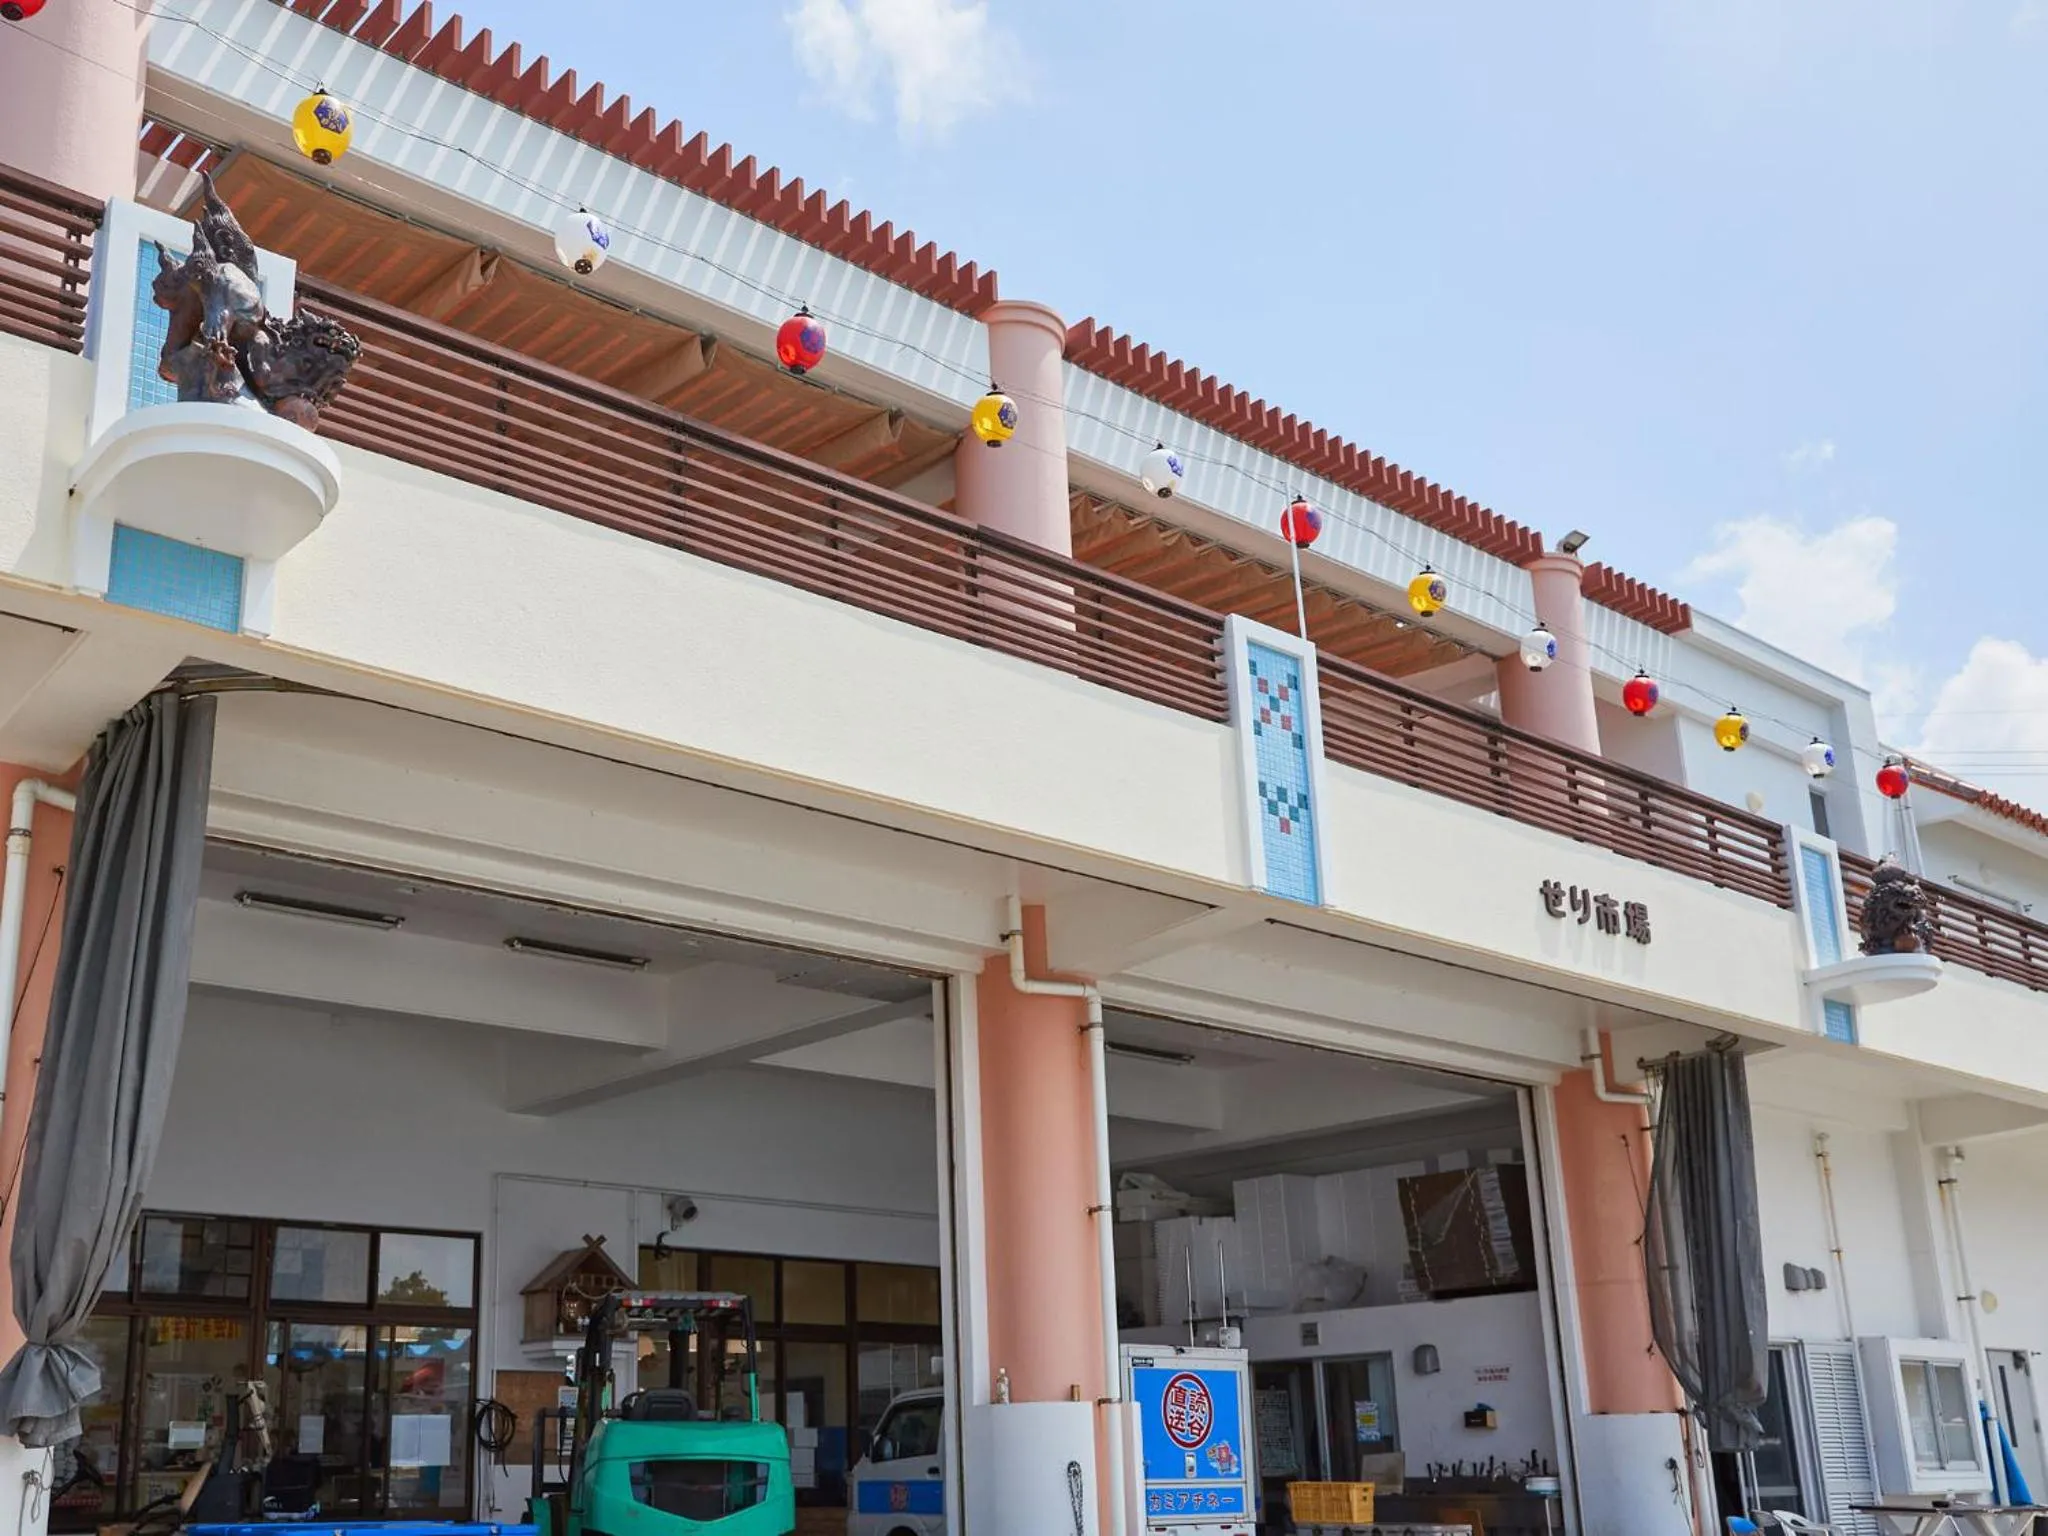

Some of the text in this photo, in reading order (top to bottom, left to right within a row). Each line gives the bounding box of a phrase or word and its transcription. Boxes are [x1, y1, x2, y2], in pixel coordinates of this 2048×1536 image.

[1539, 879, 1651, 944] せり市場
[1168, 1386, 1187, 1433] 直送
[1188, 1389, 1208, 1437] 読谷
[1150, 1493, 1235, 1511] カミアチネー
